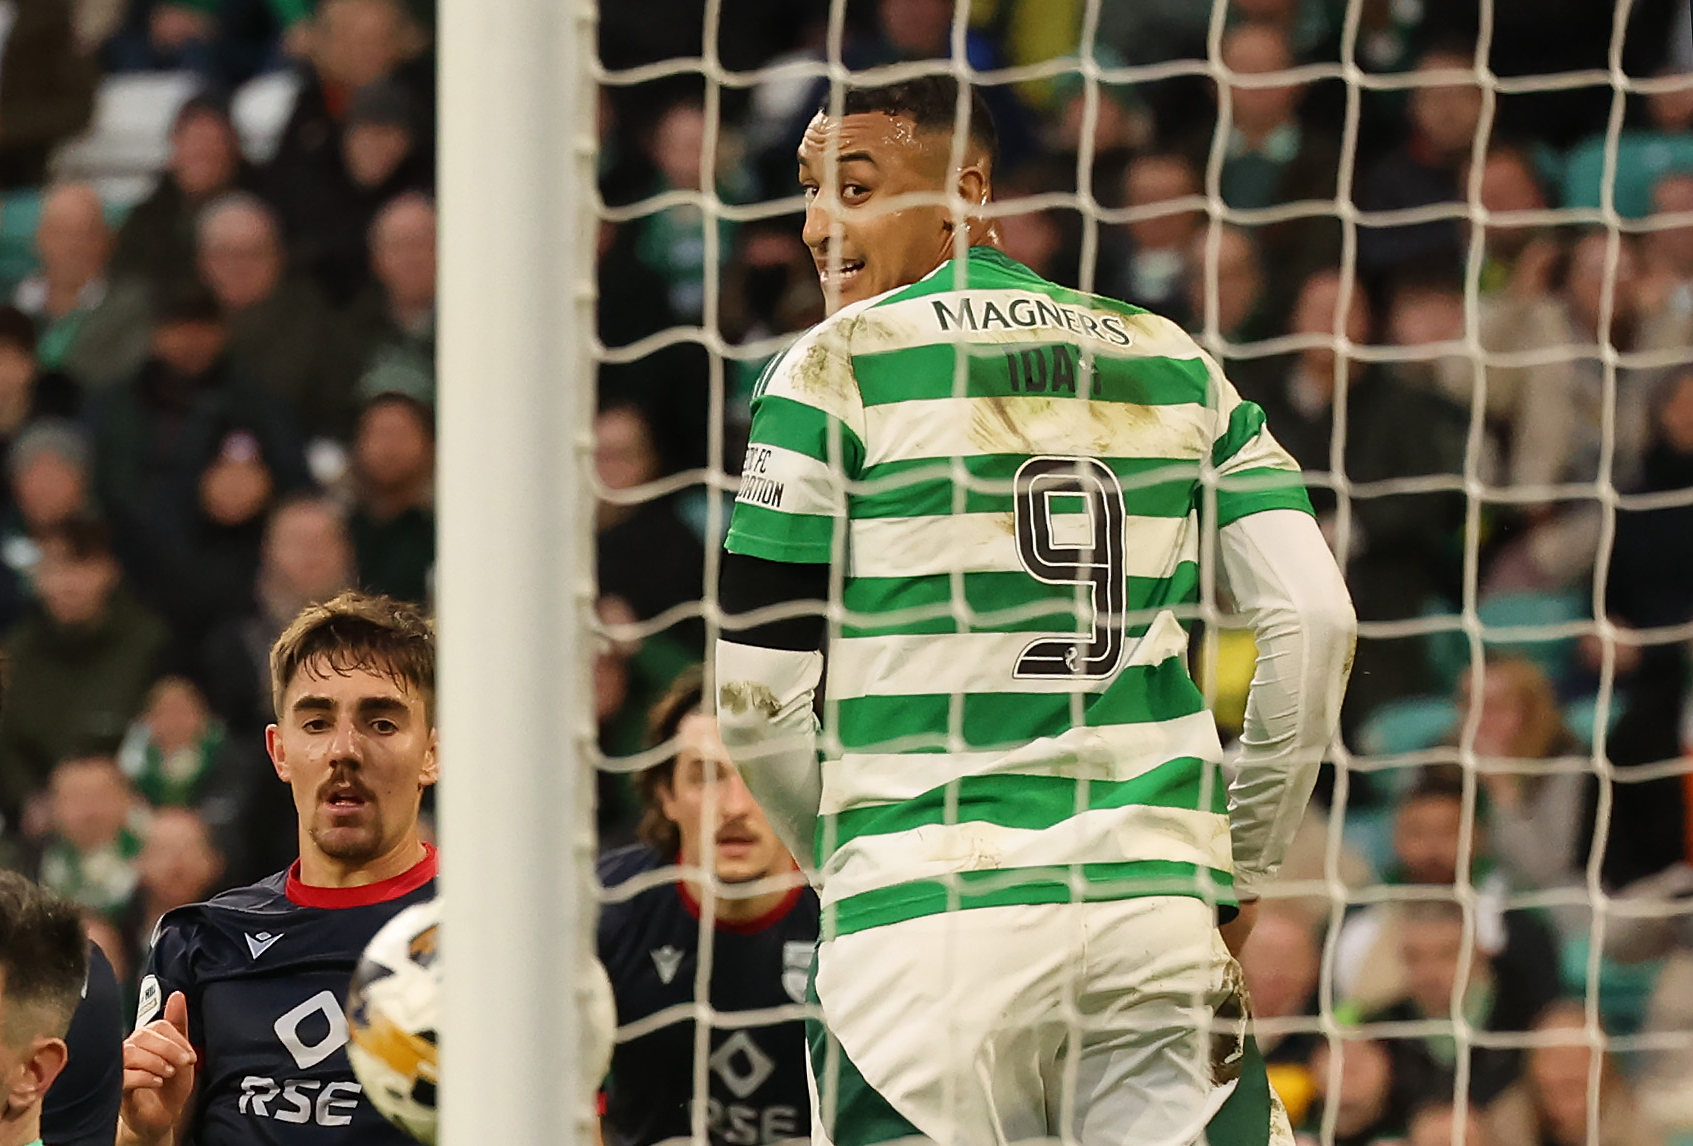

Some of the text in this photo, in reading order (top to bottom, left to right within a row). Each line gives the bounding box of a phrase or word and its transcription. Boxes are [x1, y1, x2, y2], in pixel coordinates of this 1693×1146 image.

[931, 297, 1131, 347] MAGNERS
[1012, 454, 1127, 680] 9
[237, 1074, 363, 1128] RSE
